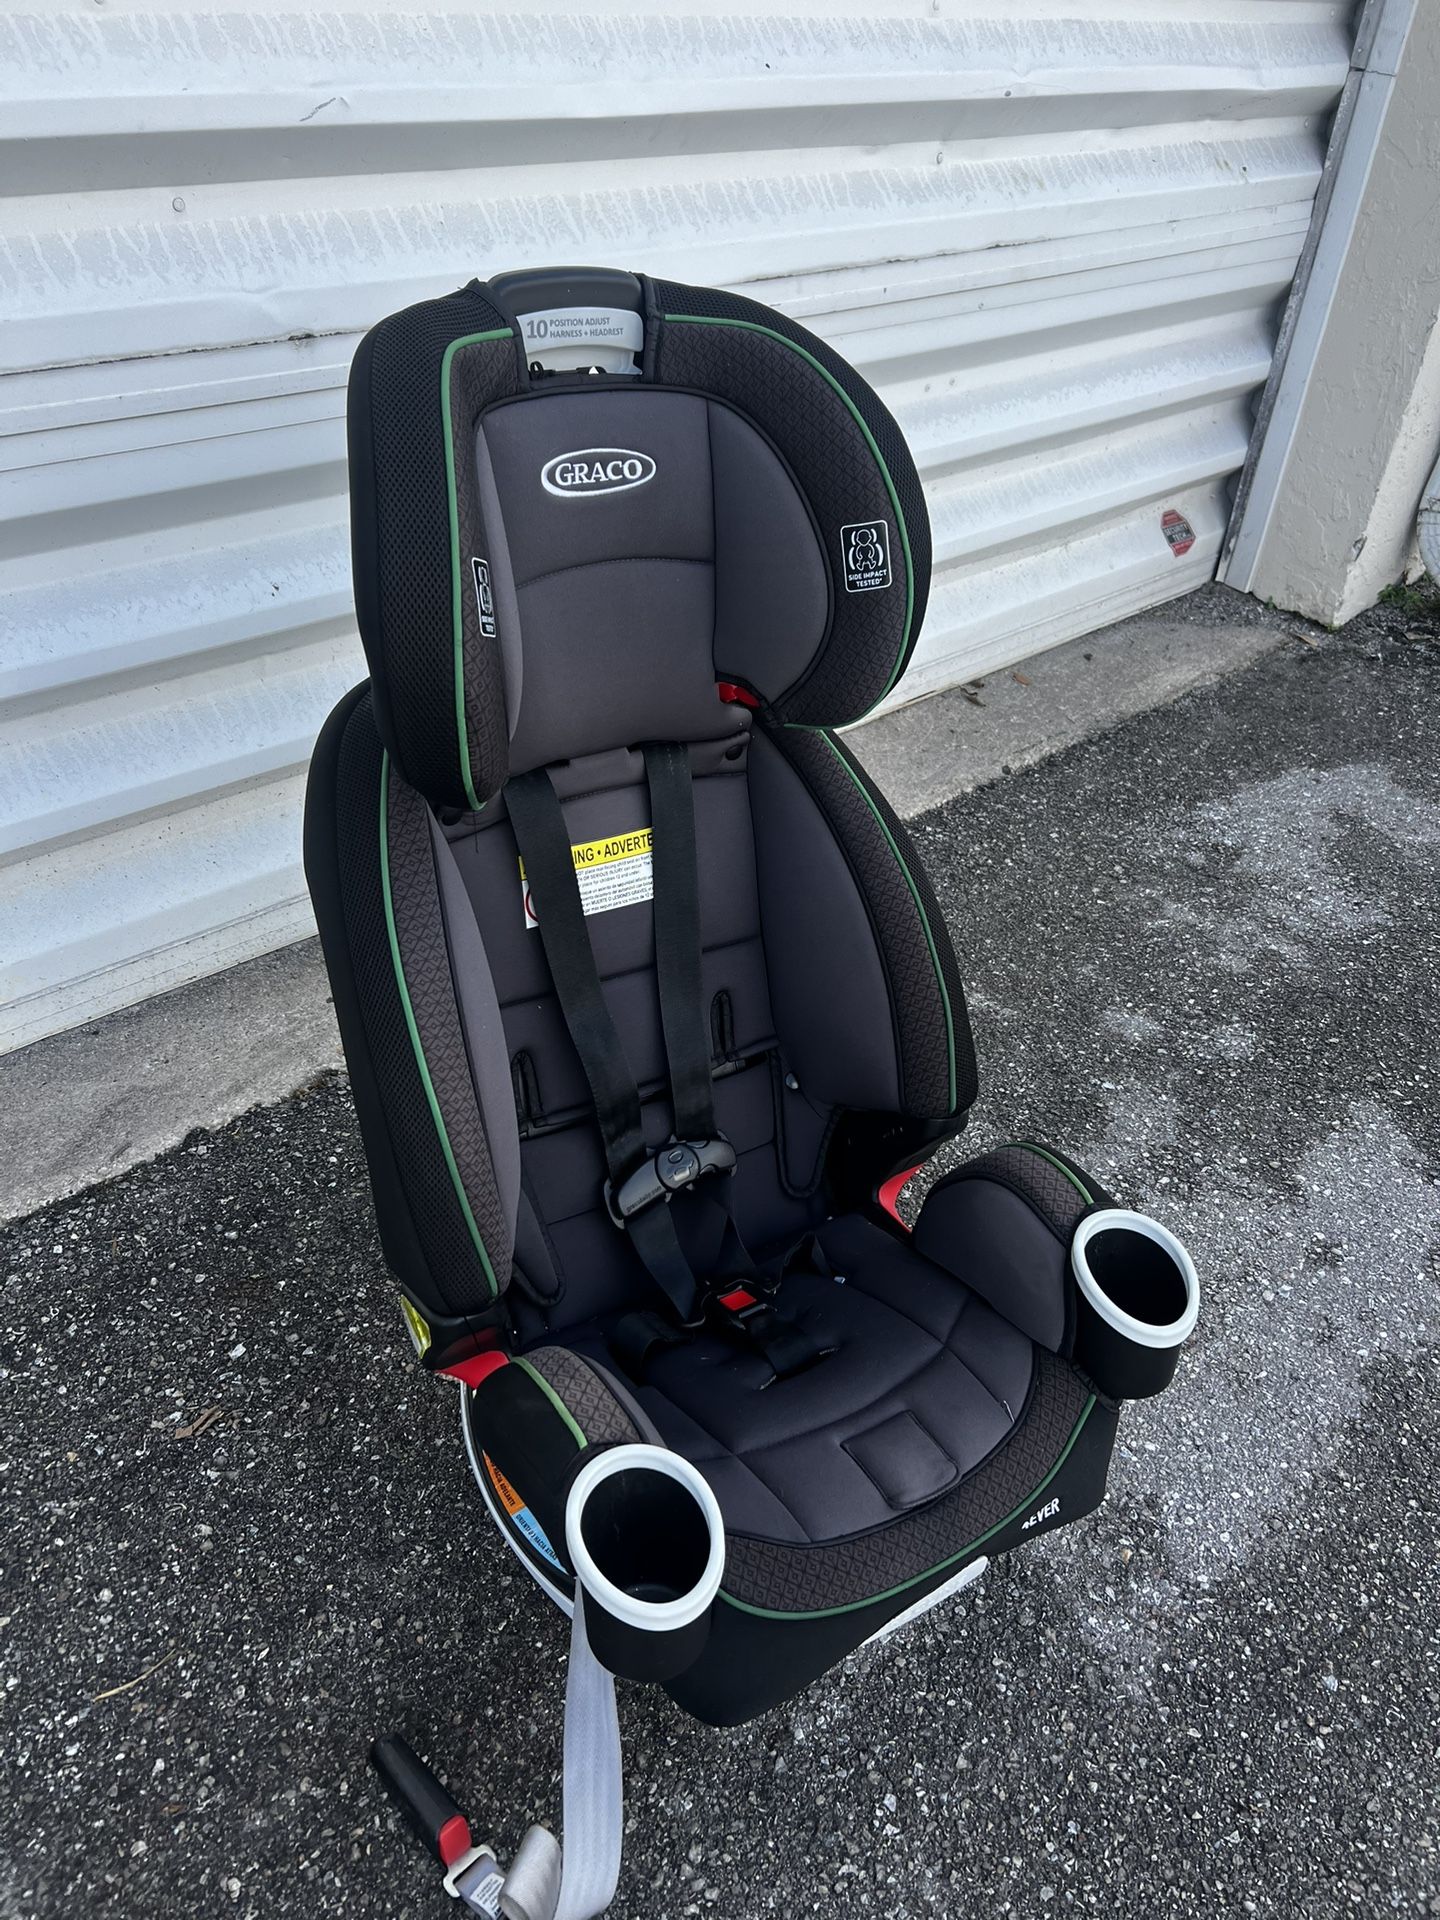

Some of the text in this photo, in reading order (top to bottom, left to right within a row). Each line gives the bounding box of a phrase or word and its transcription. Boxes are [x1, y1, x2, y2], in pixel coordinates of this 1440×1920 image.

[527, 317, 611, 339] 10 POSITION ADJUST
[549, 329, 583, 338] HARNESS
[589, 327, 624, 337] HEADREST
[555, 459, 643, 486] GRACO
[848, 569, 887, 581] SIDE IMPACT
